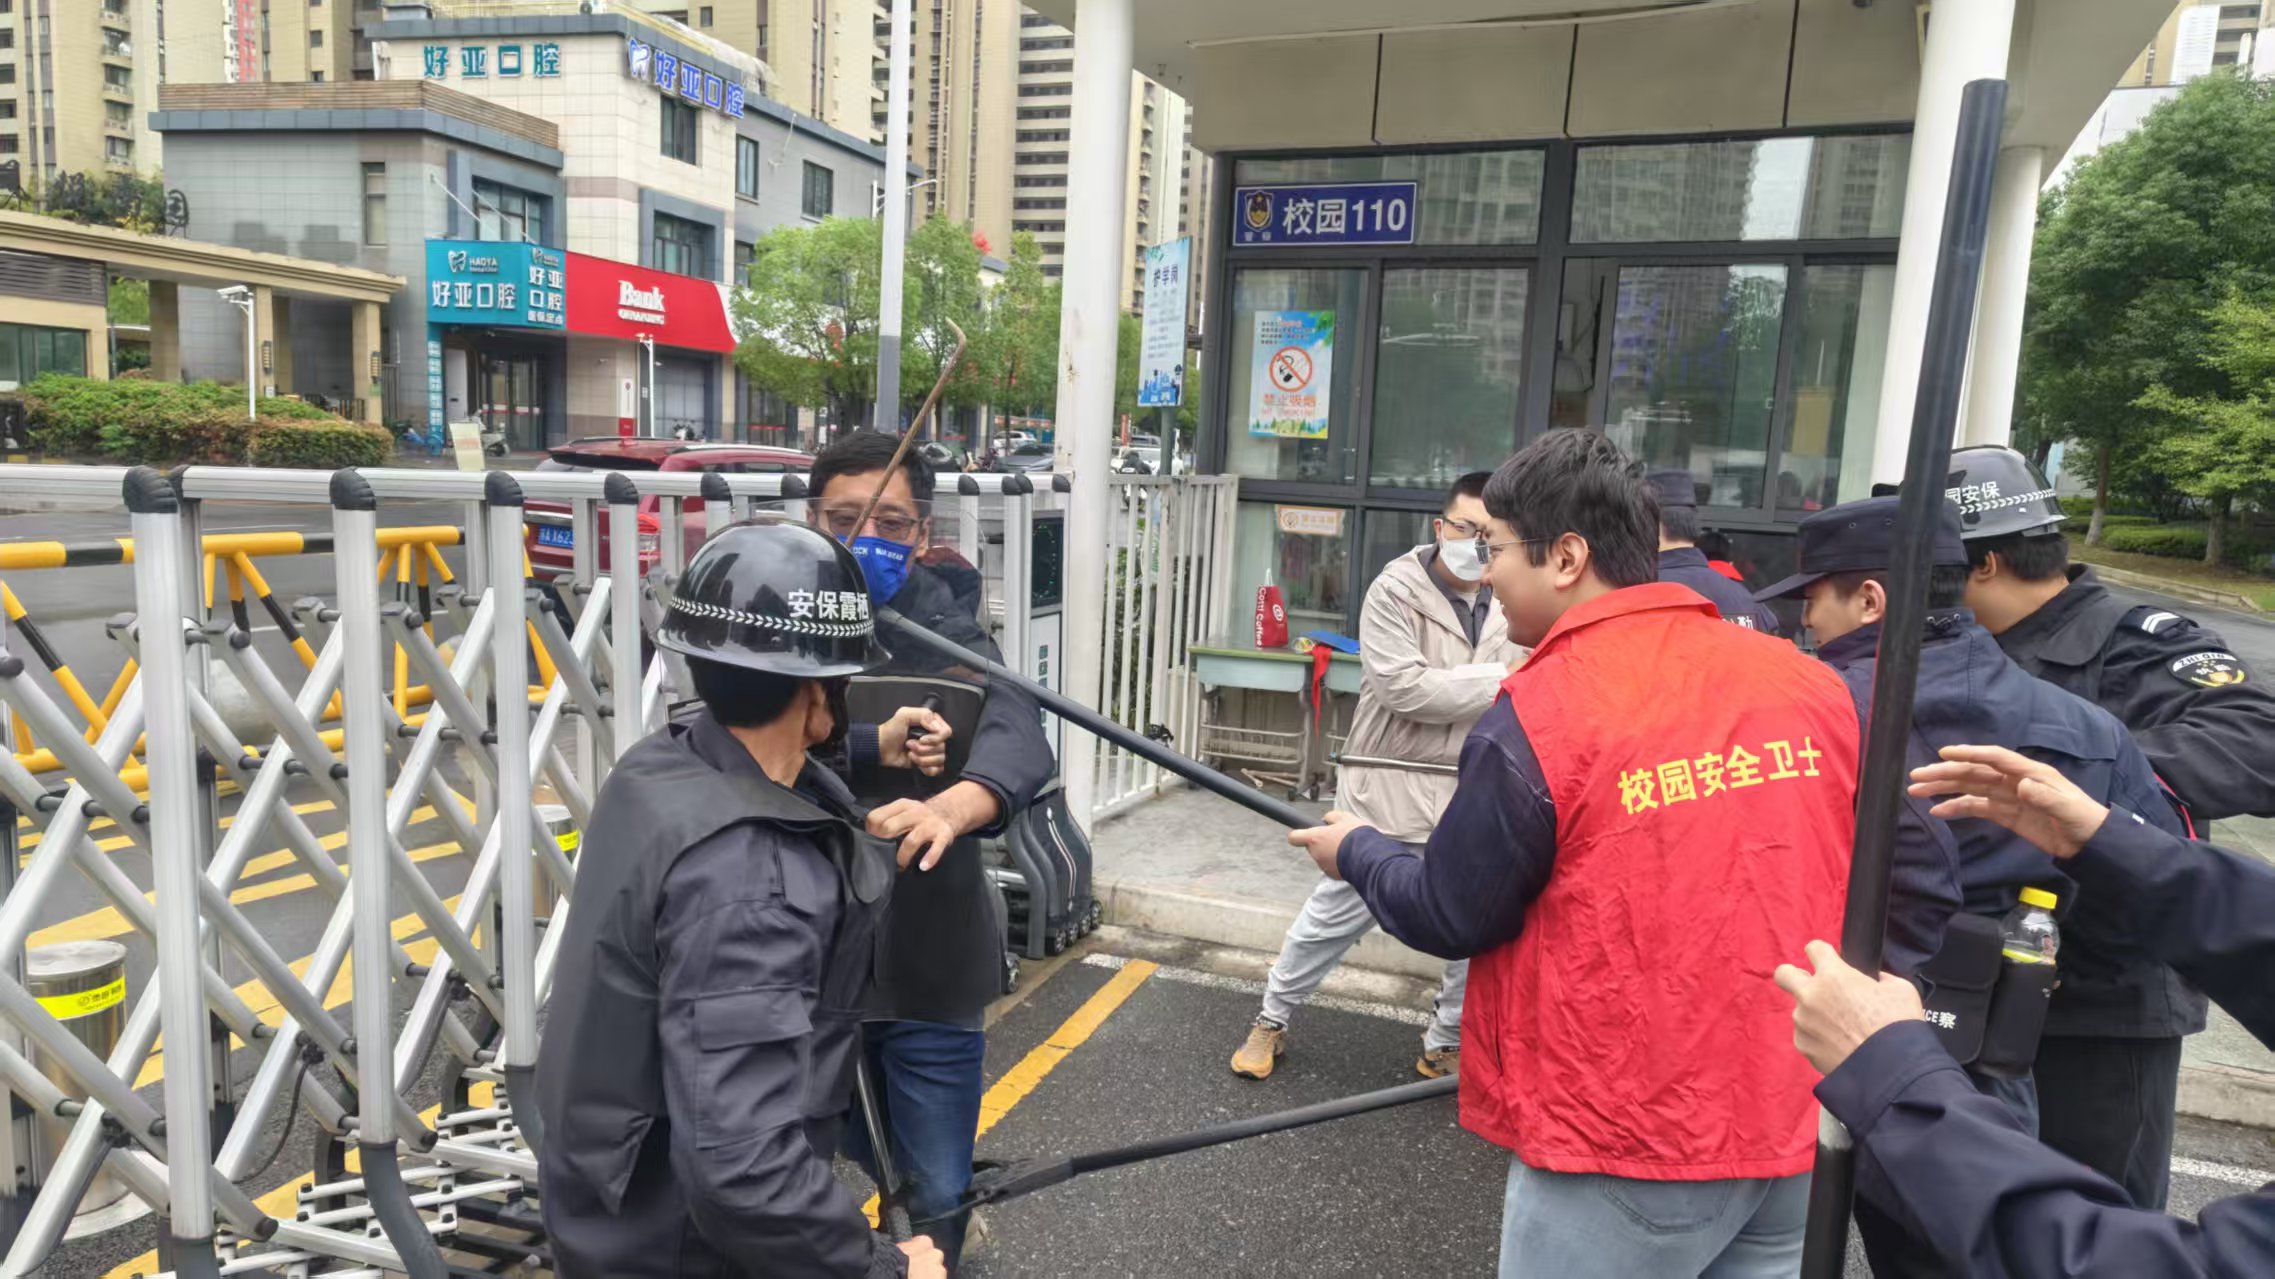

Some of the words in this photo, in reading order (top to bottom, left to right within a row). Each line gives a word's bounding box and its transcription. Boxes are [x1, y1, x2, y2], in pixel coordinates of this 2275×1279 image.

[424, 43, 561, 78] 好亚口腔
[655, 51, 745, 119] 好亚口腔
[1283, 198, 1407, 236] 校园110
[529, 265, 563, 289] 好亚
[431, 280, 517, 309] 好亚口腔
[529, 289, 563, 311] 口腔
[618, 280, 666, 312] Bank
[1258, 587, 1266, 612] Cotti
[1617, 736, 1822, 815] 校园安全卫士
